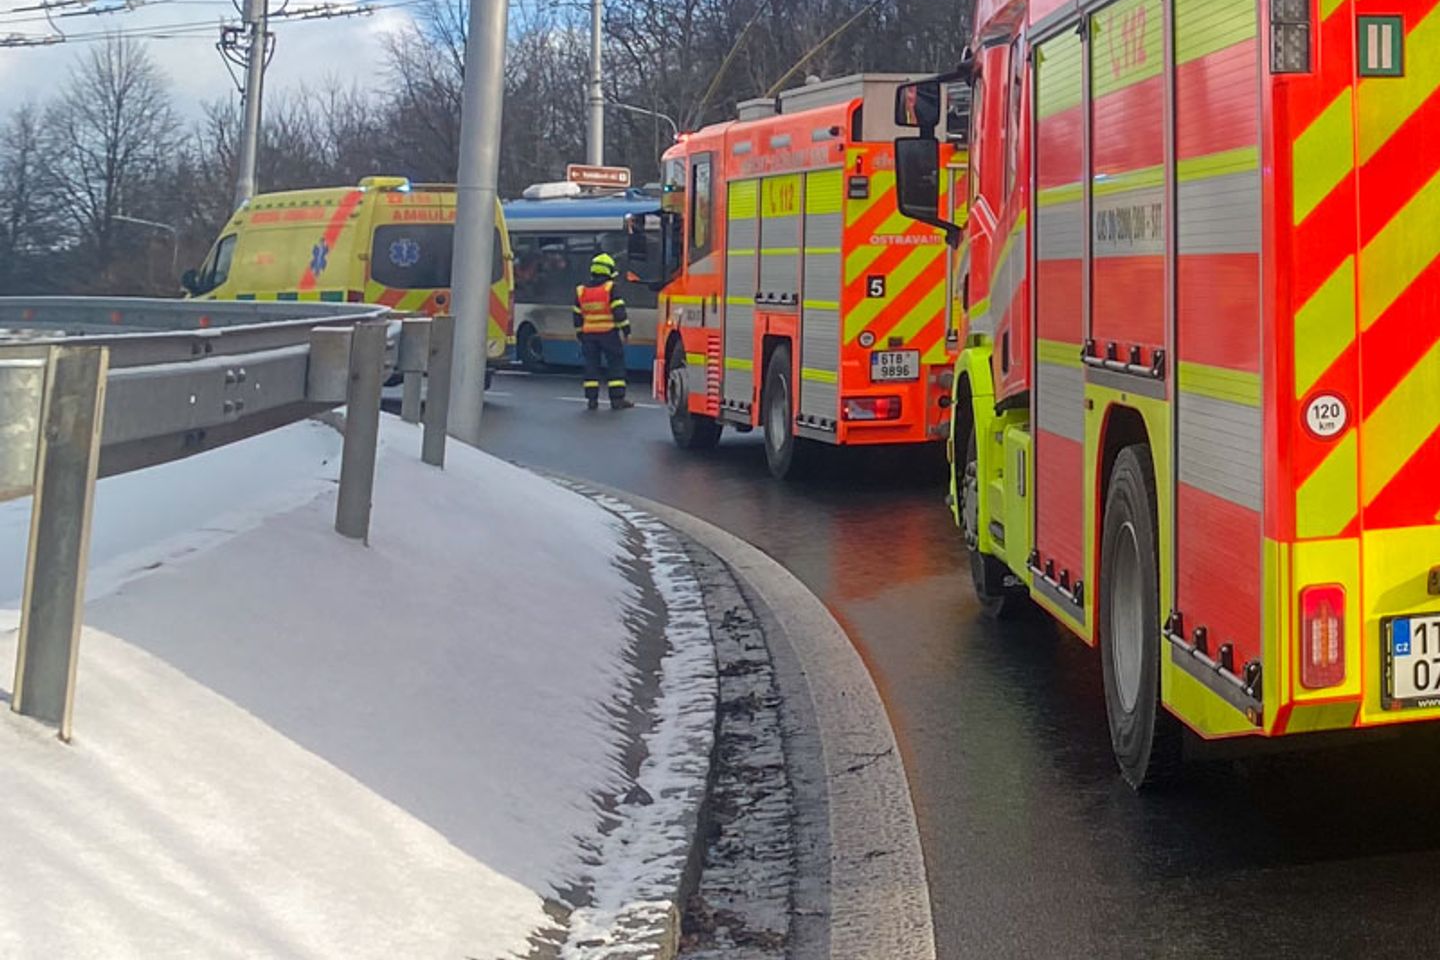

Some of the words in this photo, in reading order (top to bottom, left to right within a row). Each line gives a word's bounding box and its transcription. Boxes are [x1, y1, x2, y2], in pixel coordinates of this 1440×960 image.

[392, 209, 457, 223] AMBULA
[870, 279, 883, 296] 5
[1313, 403, 1340, 419] 120
[1319, 421, 1335, 431] km
